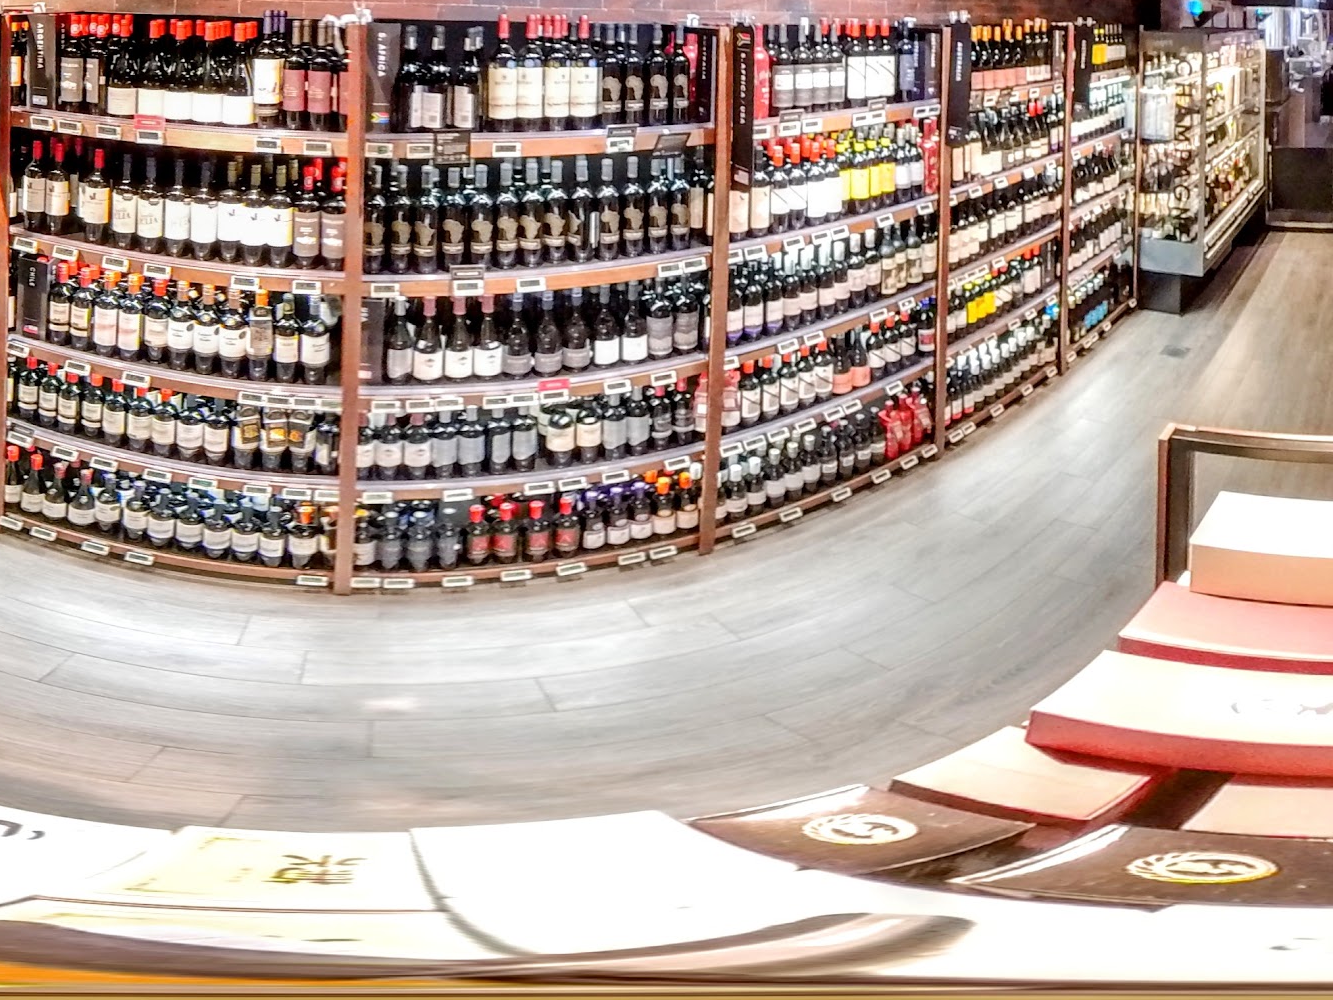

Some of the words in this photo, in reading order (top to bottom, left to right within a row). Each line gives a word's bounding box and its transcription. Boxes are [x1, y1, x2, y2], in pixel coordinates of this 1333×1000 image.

[35, 22, 45, 69] ARGENTINA
[378, 44, 386, 77] AFRICA
[28, 266, 36, 287] CHILE
